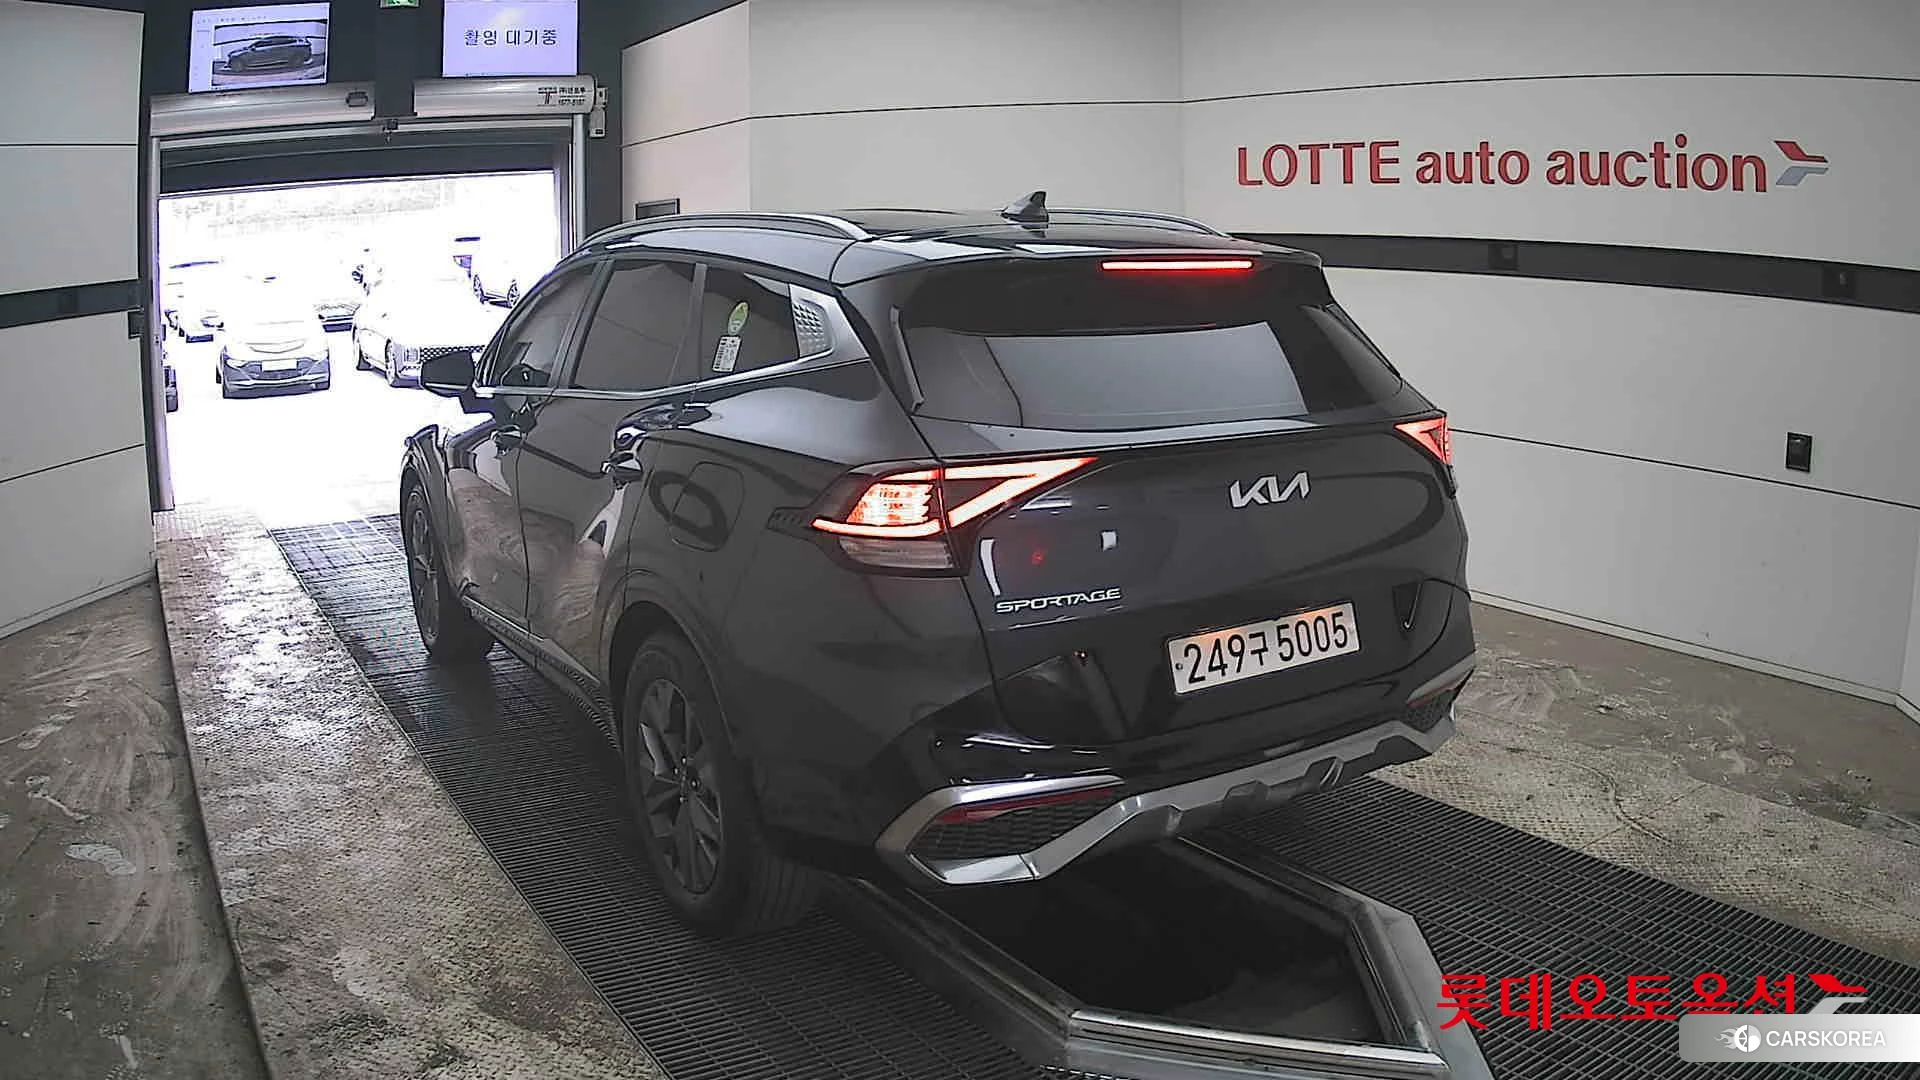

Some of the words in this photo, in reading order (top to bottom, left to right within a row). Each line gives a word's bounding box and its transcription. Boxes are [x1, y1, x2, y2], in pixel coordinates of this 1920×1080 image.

[506, 29, 557, 46] 대기중
[1238, 140, 1400, 187] LOTTE
[1416, 141, 1530, 185] auto
[1546, 133, 1767, 192] auction
[996, 587, 1121, 613] SPORTAGE
[1184, 631, 1269, 684] 249구
[1276, 611, 1348, 662] 5005
